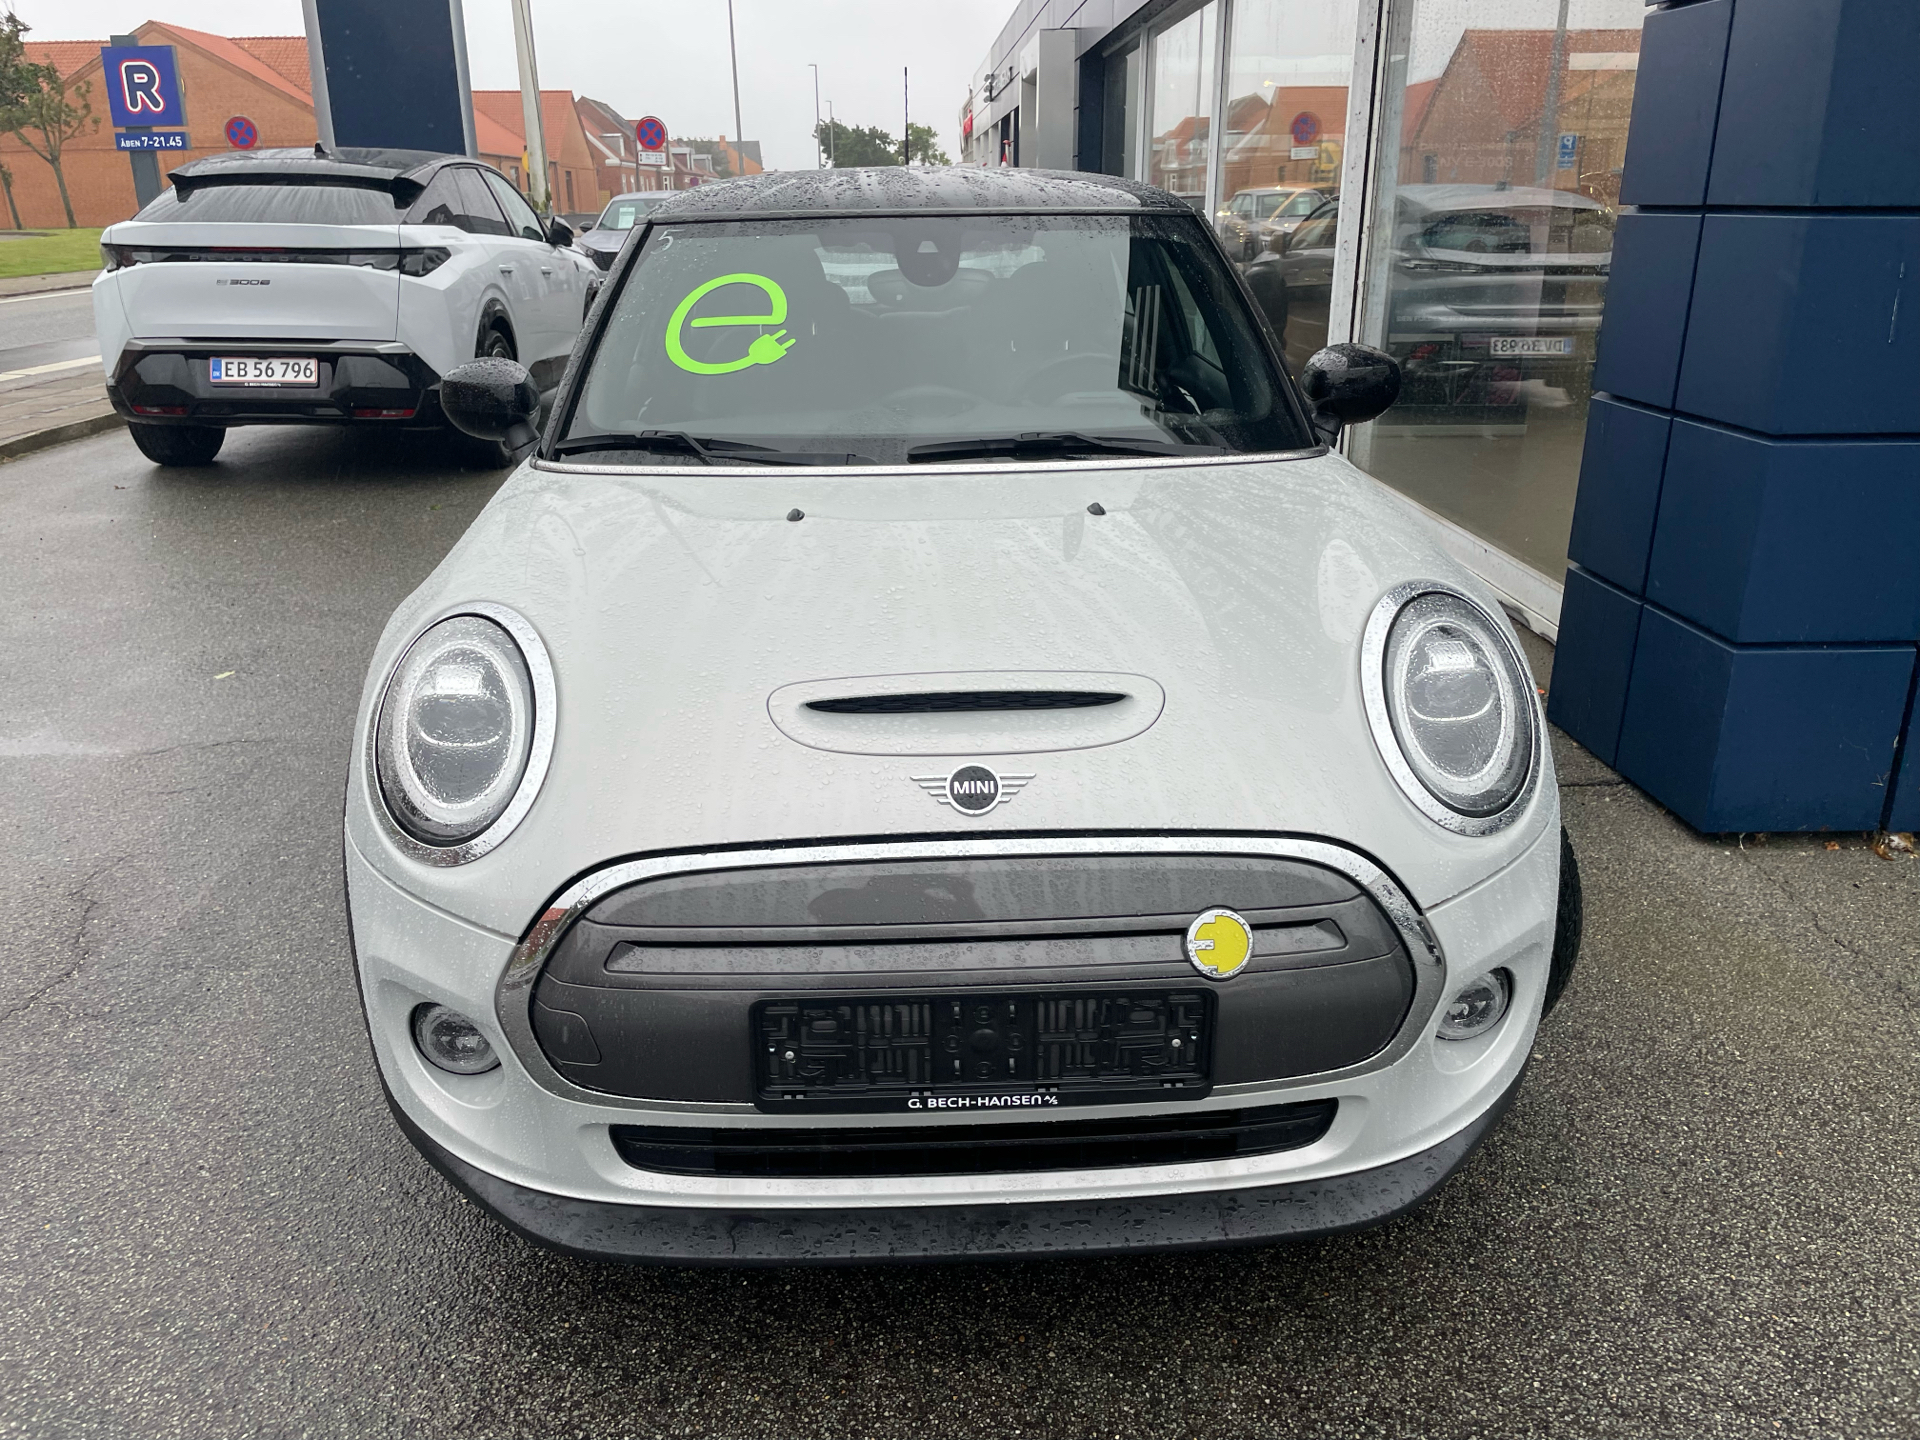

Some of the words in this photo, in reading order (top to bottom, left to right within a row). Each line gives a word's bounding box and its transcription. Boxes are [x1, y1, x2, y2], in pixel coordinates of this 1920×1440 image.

[119, 59, 165, 114] R
[121, 137, 140, 147] ÅBEN
[141, 136, 182, 147] 7-21.45
[225, 361, 248, 378] EB
[253, 361, 275, 378] 56
[280, 361, 313, 379] 796
[953, 780, 995, 795] MINI
[907, 1098, 923, 1109] G.
[927, 1095, 1042, 1108] BECH-HANSEN
[1044, 1095, 1058, 1105] A/S
